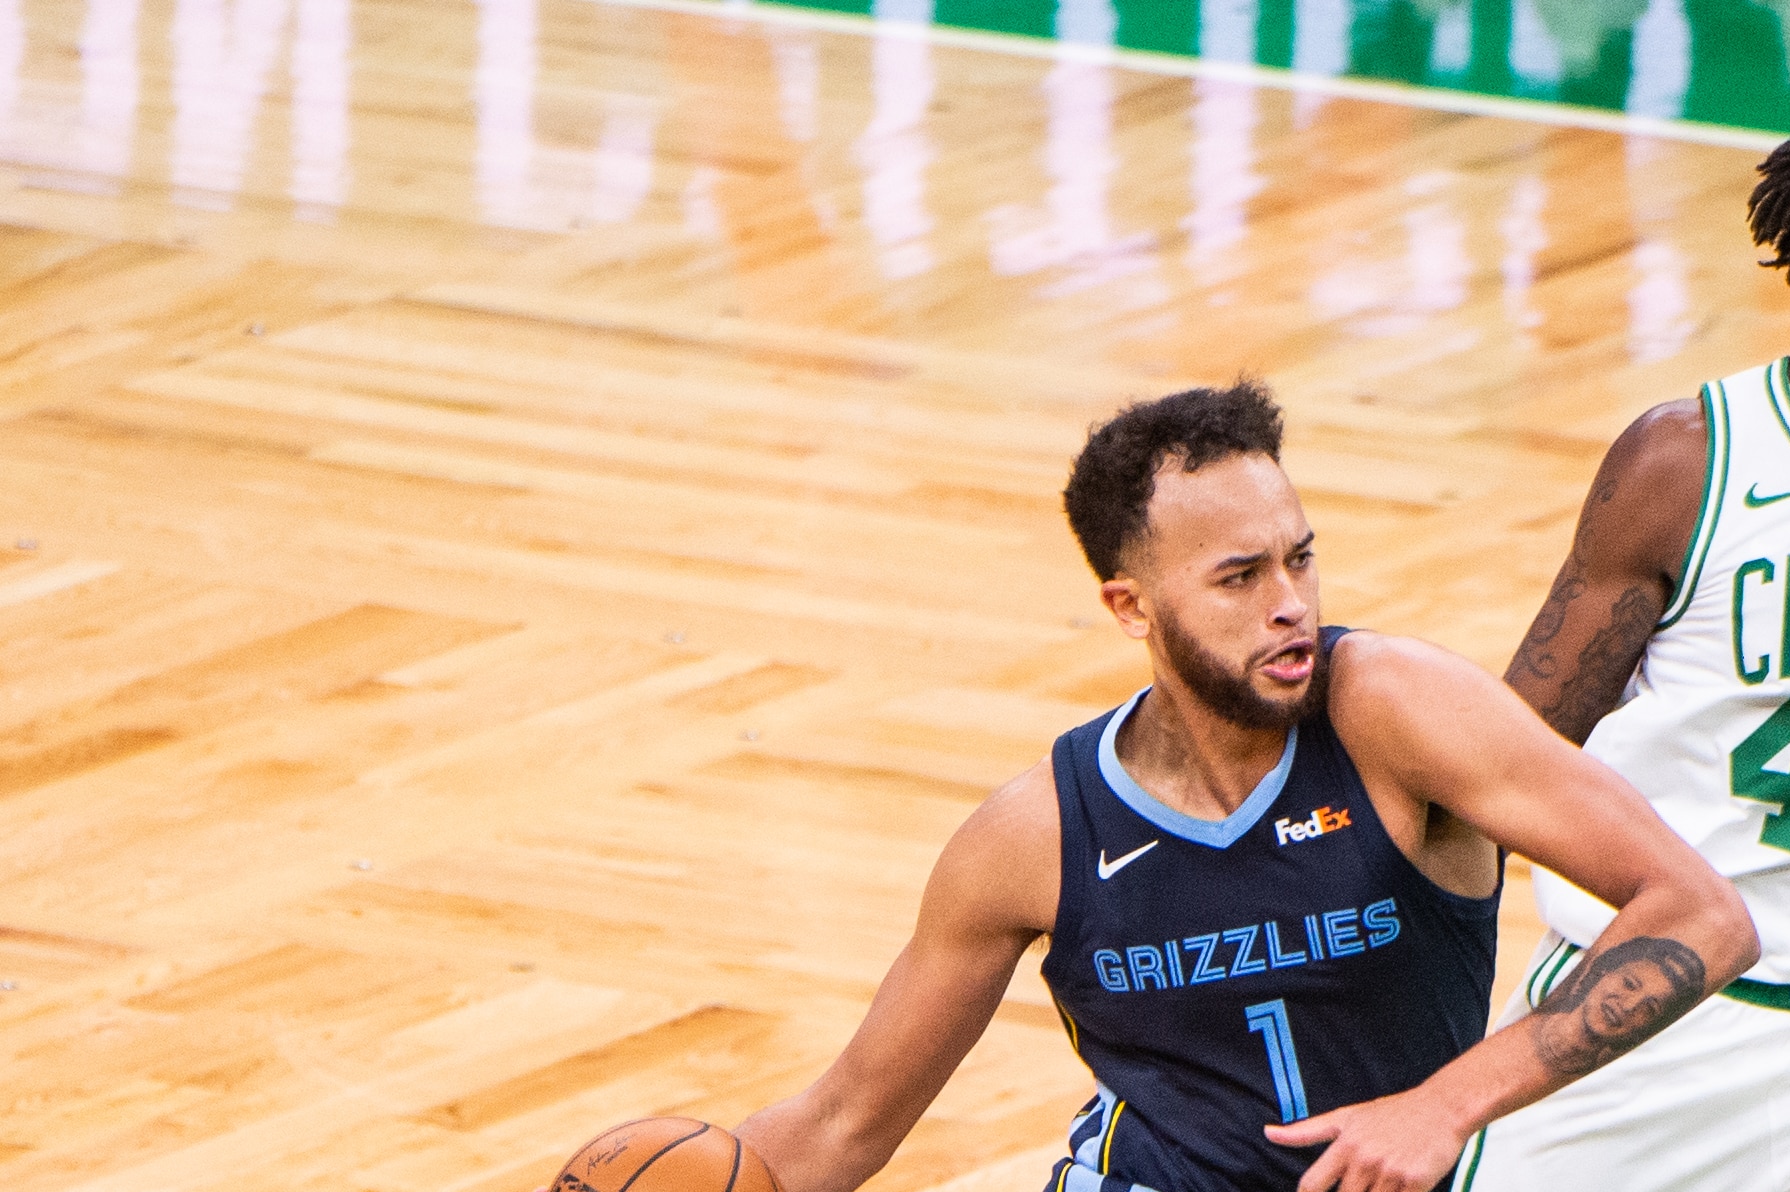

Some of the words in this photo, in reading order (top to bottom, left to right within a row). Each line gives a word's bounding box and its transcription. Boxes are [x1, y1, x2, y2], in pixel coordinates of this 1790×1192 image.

[1274, 805, 1353, 846] FedEx
[1093, 898, 1401, 993] GRIZZLIES
[1245, 998, 1309, 1124] 1
